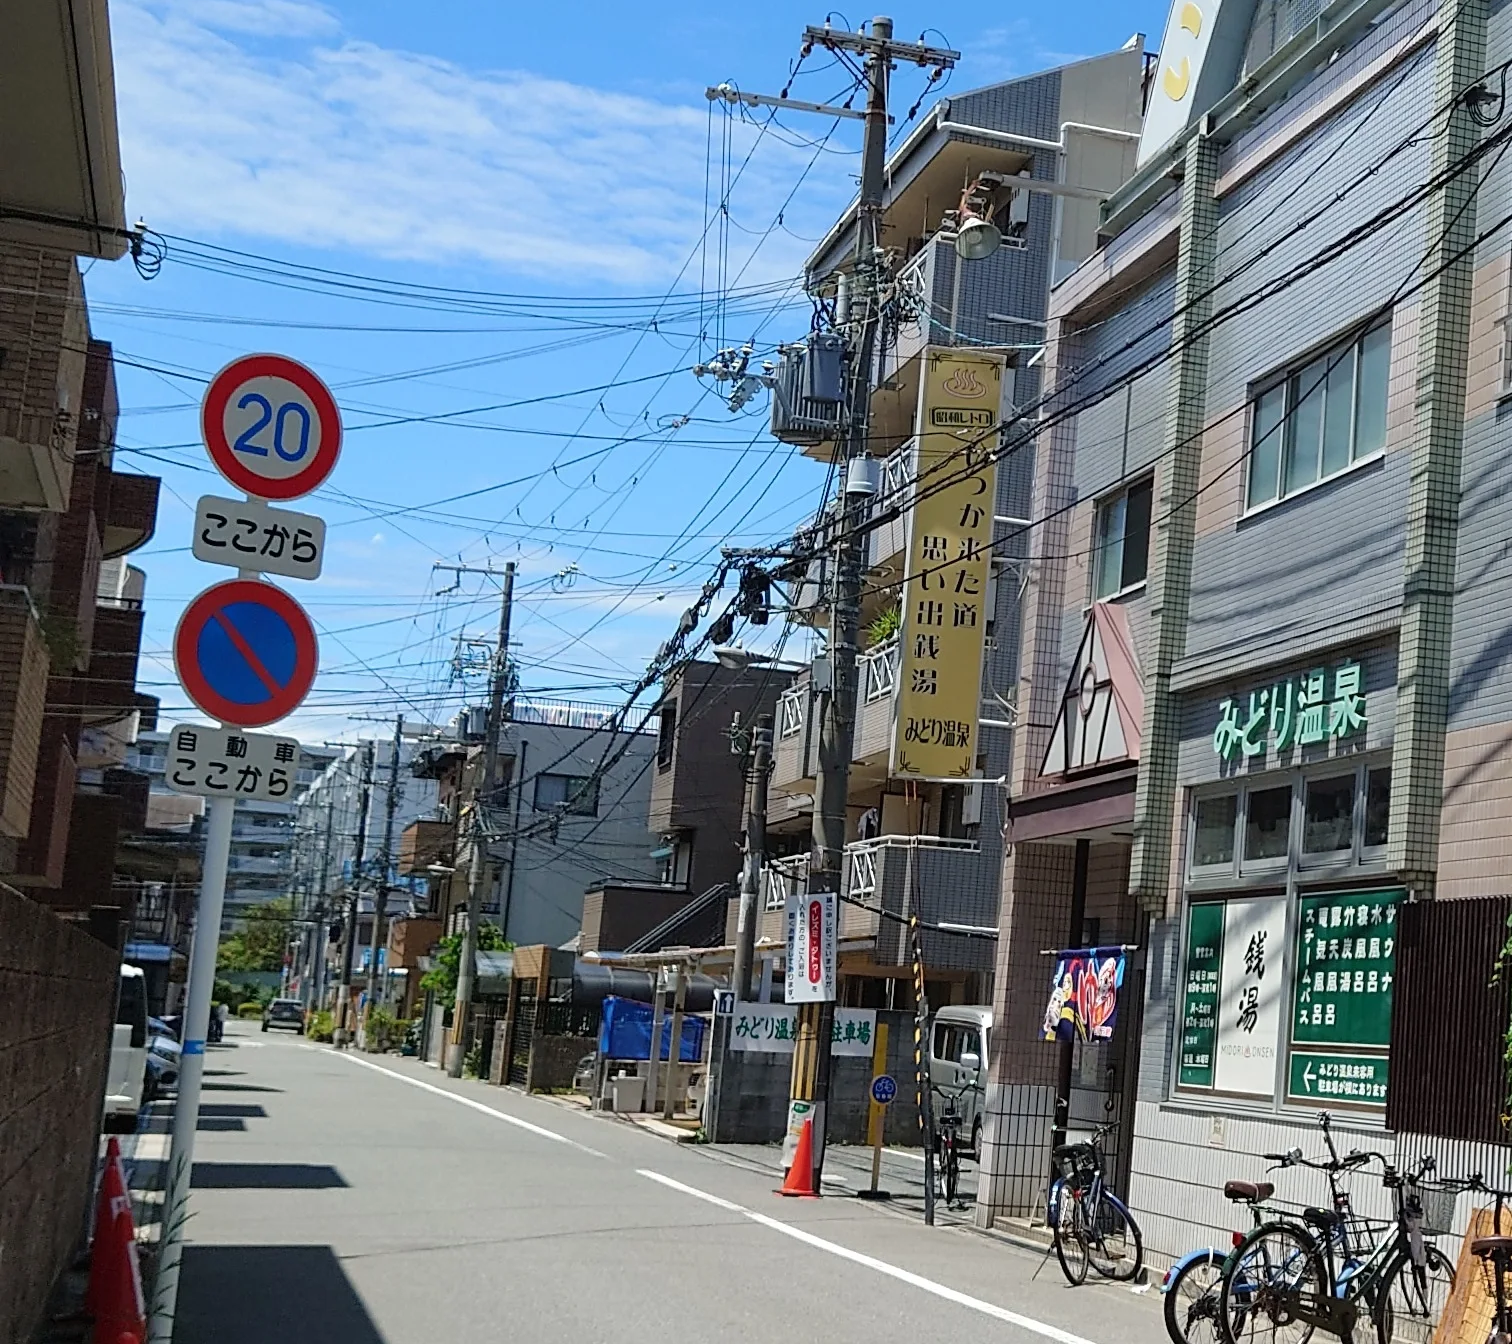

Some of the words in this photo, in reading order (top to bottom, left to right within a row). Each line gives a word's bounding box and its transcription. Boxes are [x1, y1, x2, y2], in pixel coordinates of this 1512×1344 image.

[233, 393, 311, 462] 20
[935, 410, 990, 425] 昭和レトロ
[201, 513, 317, 563] ここから
[911, 535, 948, 695] 思い出銭湯
[904, 717, 970, 747] みどり温泉
[1213, 661, 1369, 761] みどり温泉
[172, 758, 290, 798] ここから
[176, 730, 296, 764] 自動車
[1236, 930, 1268, 1035] 銭湯
[1311, 906, 1329, 1025] 電気風呂
[1367, 904, 1383, 993] 水風呂
[1382, 904, 1397, 993] サウナ
[1221, 1044, 1244, 1057] MIDORI
[1252, 1046, 1275, 1059] ONSEN
